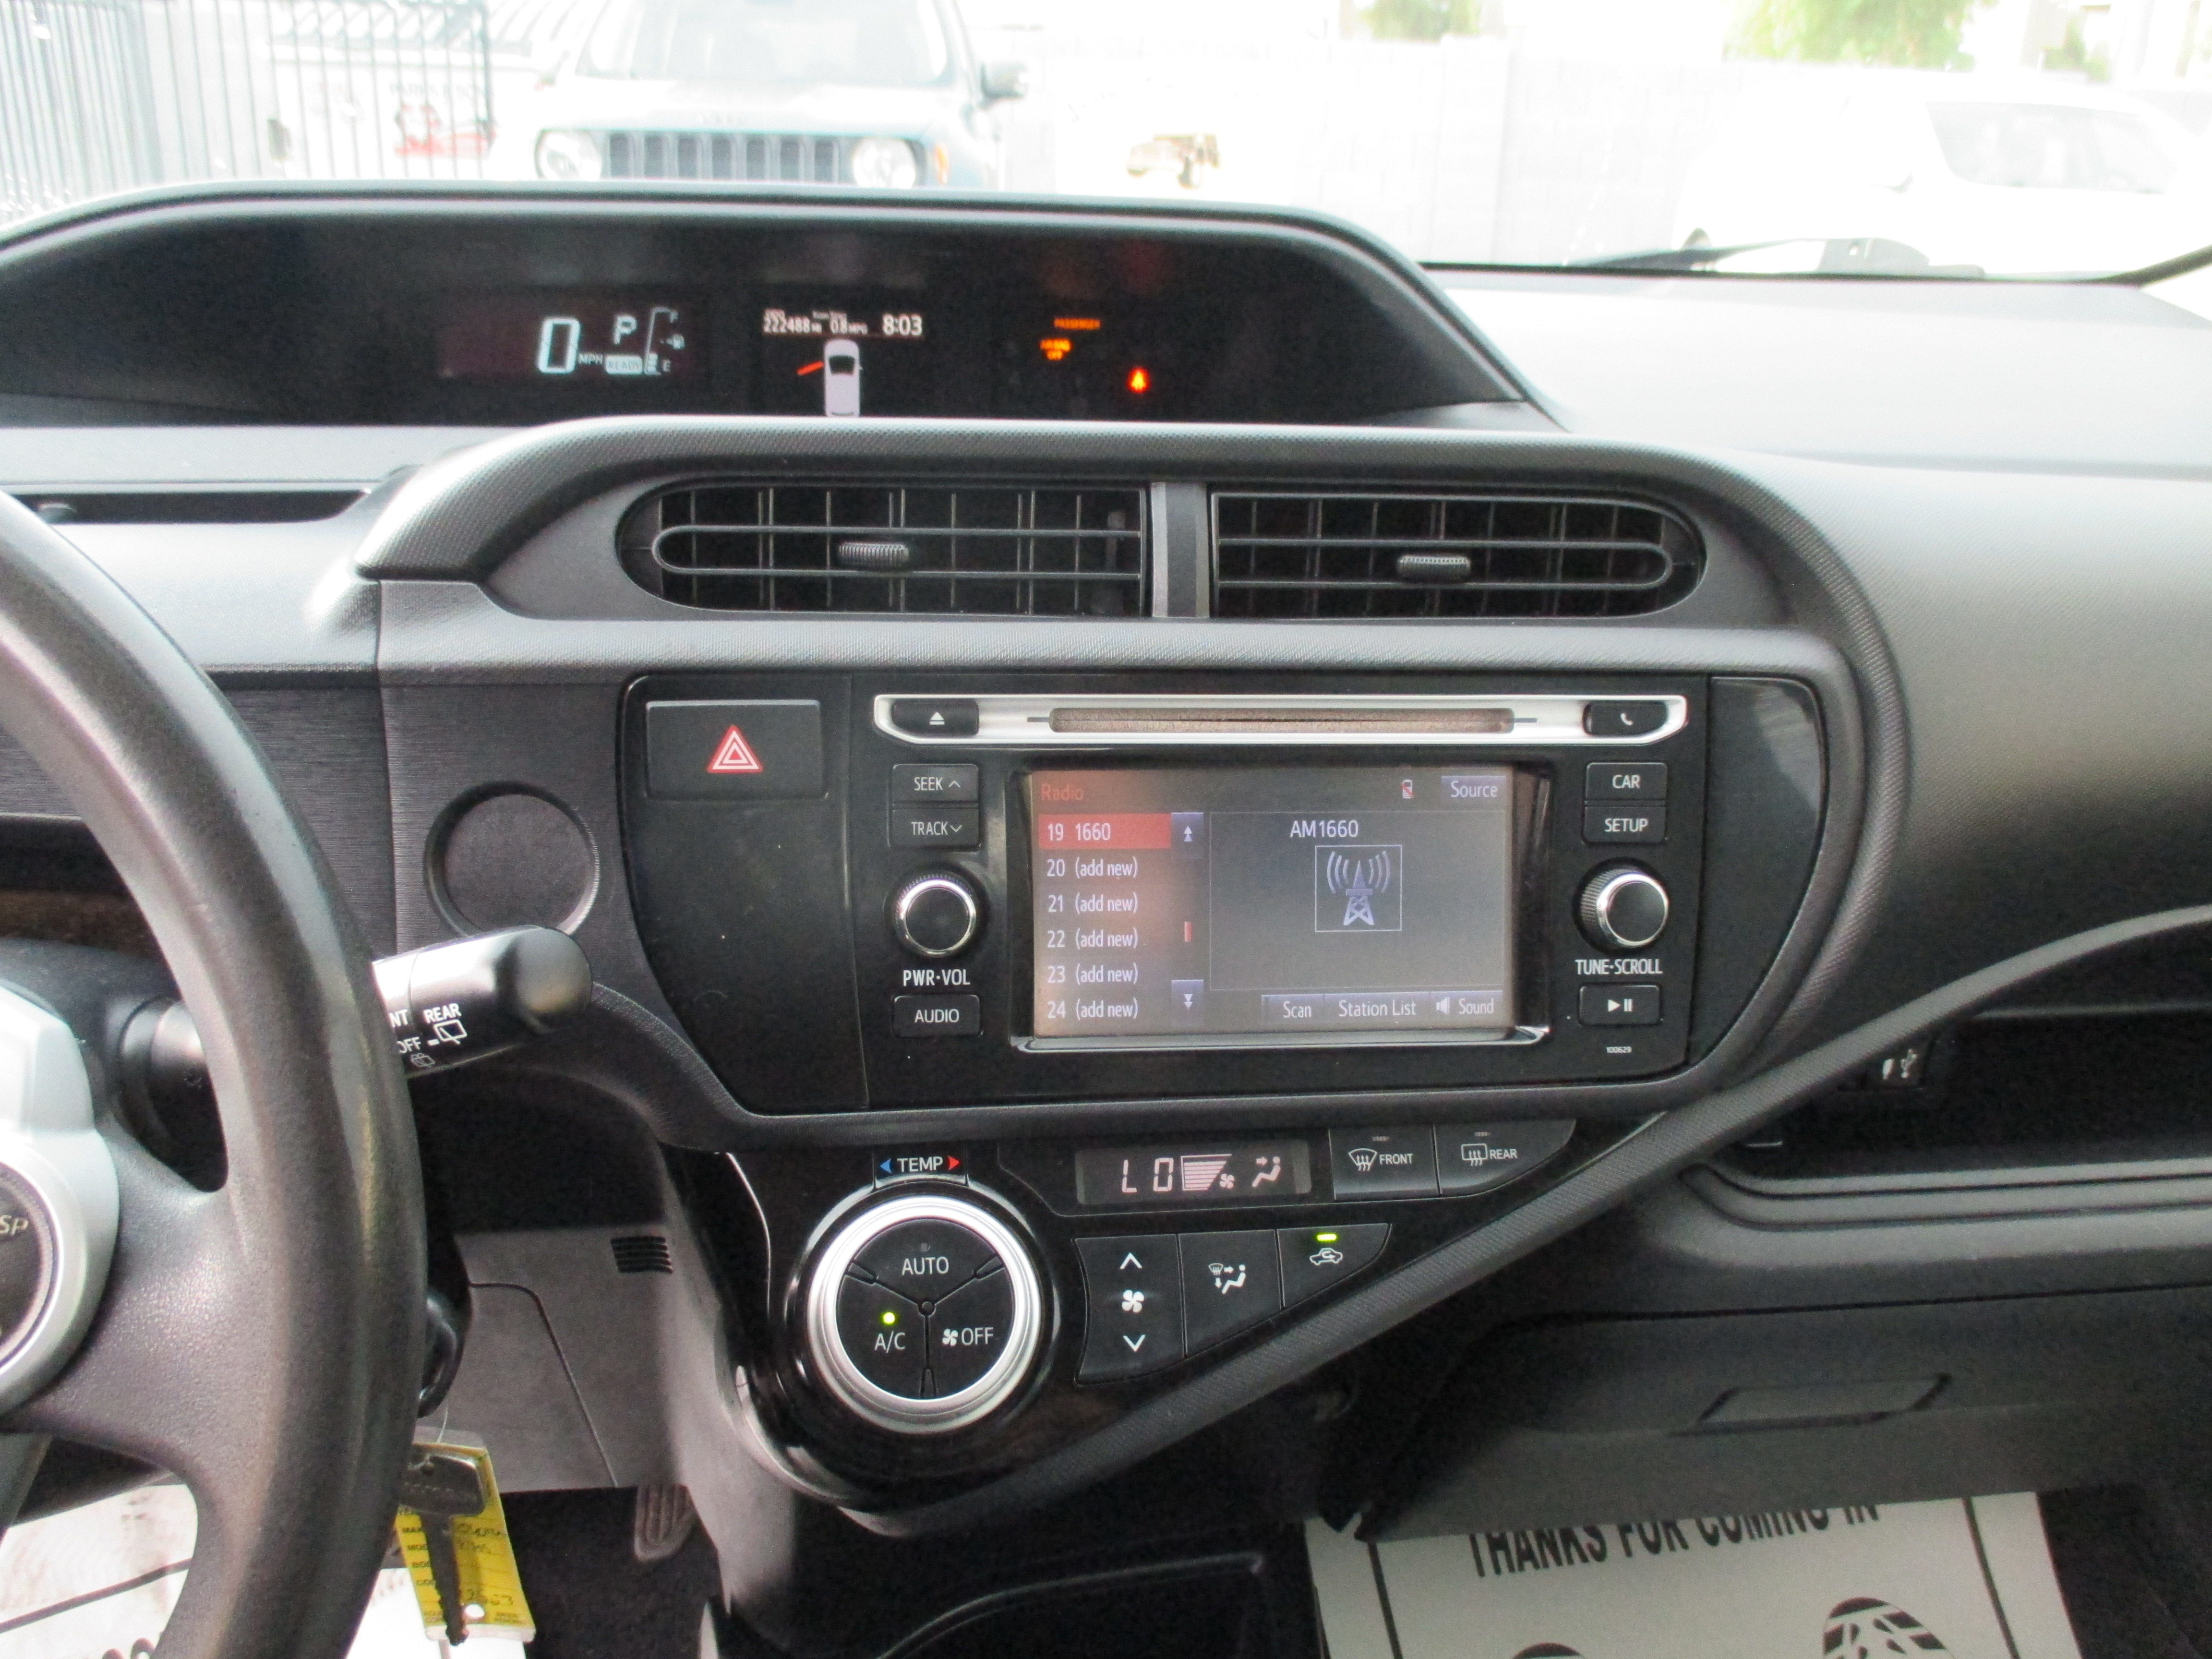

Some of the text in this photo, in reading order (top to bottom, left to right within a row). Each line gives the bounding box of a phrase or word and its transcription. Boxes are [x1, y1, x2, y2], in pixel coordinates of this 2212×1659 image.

[613, 315, 637, 345] P
[882, 313, 923, 336] 8:03
[538, 317, 580, 374] 0
[914, 777, 943, 791] SEEK
[1450, 781, 1498, 798] Source
[1612, 774, 1641, 789] CAR
[1041, 783, 1084, 801] Radio
[911, 821, 948, 835] TRACK
[1048, 822, 1111, 841] 19 1660
[1604, 817, 1649, 832] SETUP
[1046, 856, 1138, 879] 20 (add new)
[1048, 891, 1138, 914] 21 (add new)
[1047, 927, 1138, 950] 22 (add new)
[1047, 962, 1138, 985] 23 (add new)
[423, 1003, 462, 1023] REAR
[1047, 997, 1139, 1021] 24 (add new)
[1283, 1000, 1312, 1018] Scan
[1338, 999, 1417, 1017] Station List
[1458, 998, 1494, 1015] Sound
[914, 1009, 960, 1023] AUDIO
[1379, 1153, 1413, 1166] FRONT
[1489, 1148, 1518, 1160] REAR
[897, 1156, 944, 1173] TEMP
[902, 1256, 950, 1275] AUTO
[874, 1332, 906, 1353] A/C
[961, 1327, 994, 1345] OFF
[1469, 1525, 1608, 1578] THANKS
